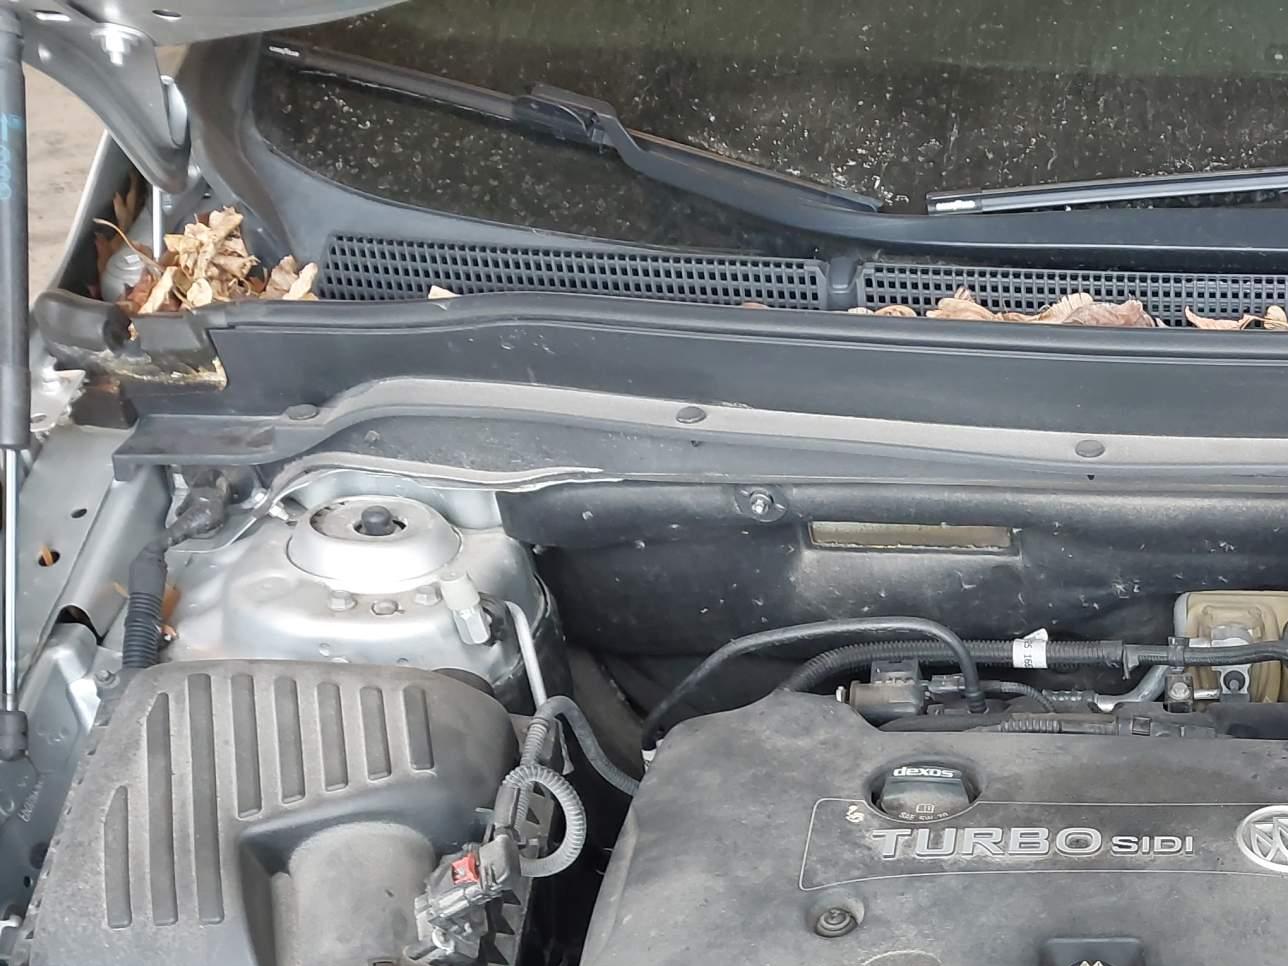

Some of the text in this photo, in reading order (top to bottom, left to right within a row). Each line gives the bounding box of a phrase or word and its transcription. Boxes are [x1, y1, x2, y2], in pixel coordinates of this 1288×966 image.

[893, 766, 954, 778] dexos
[871, 827, 1195, 859] TURBO SIDI
